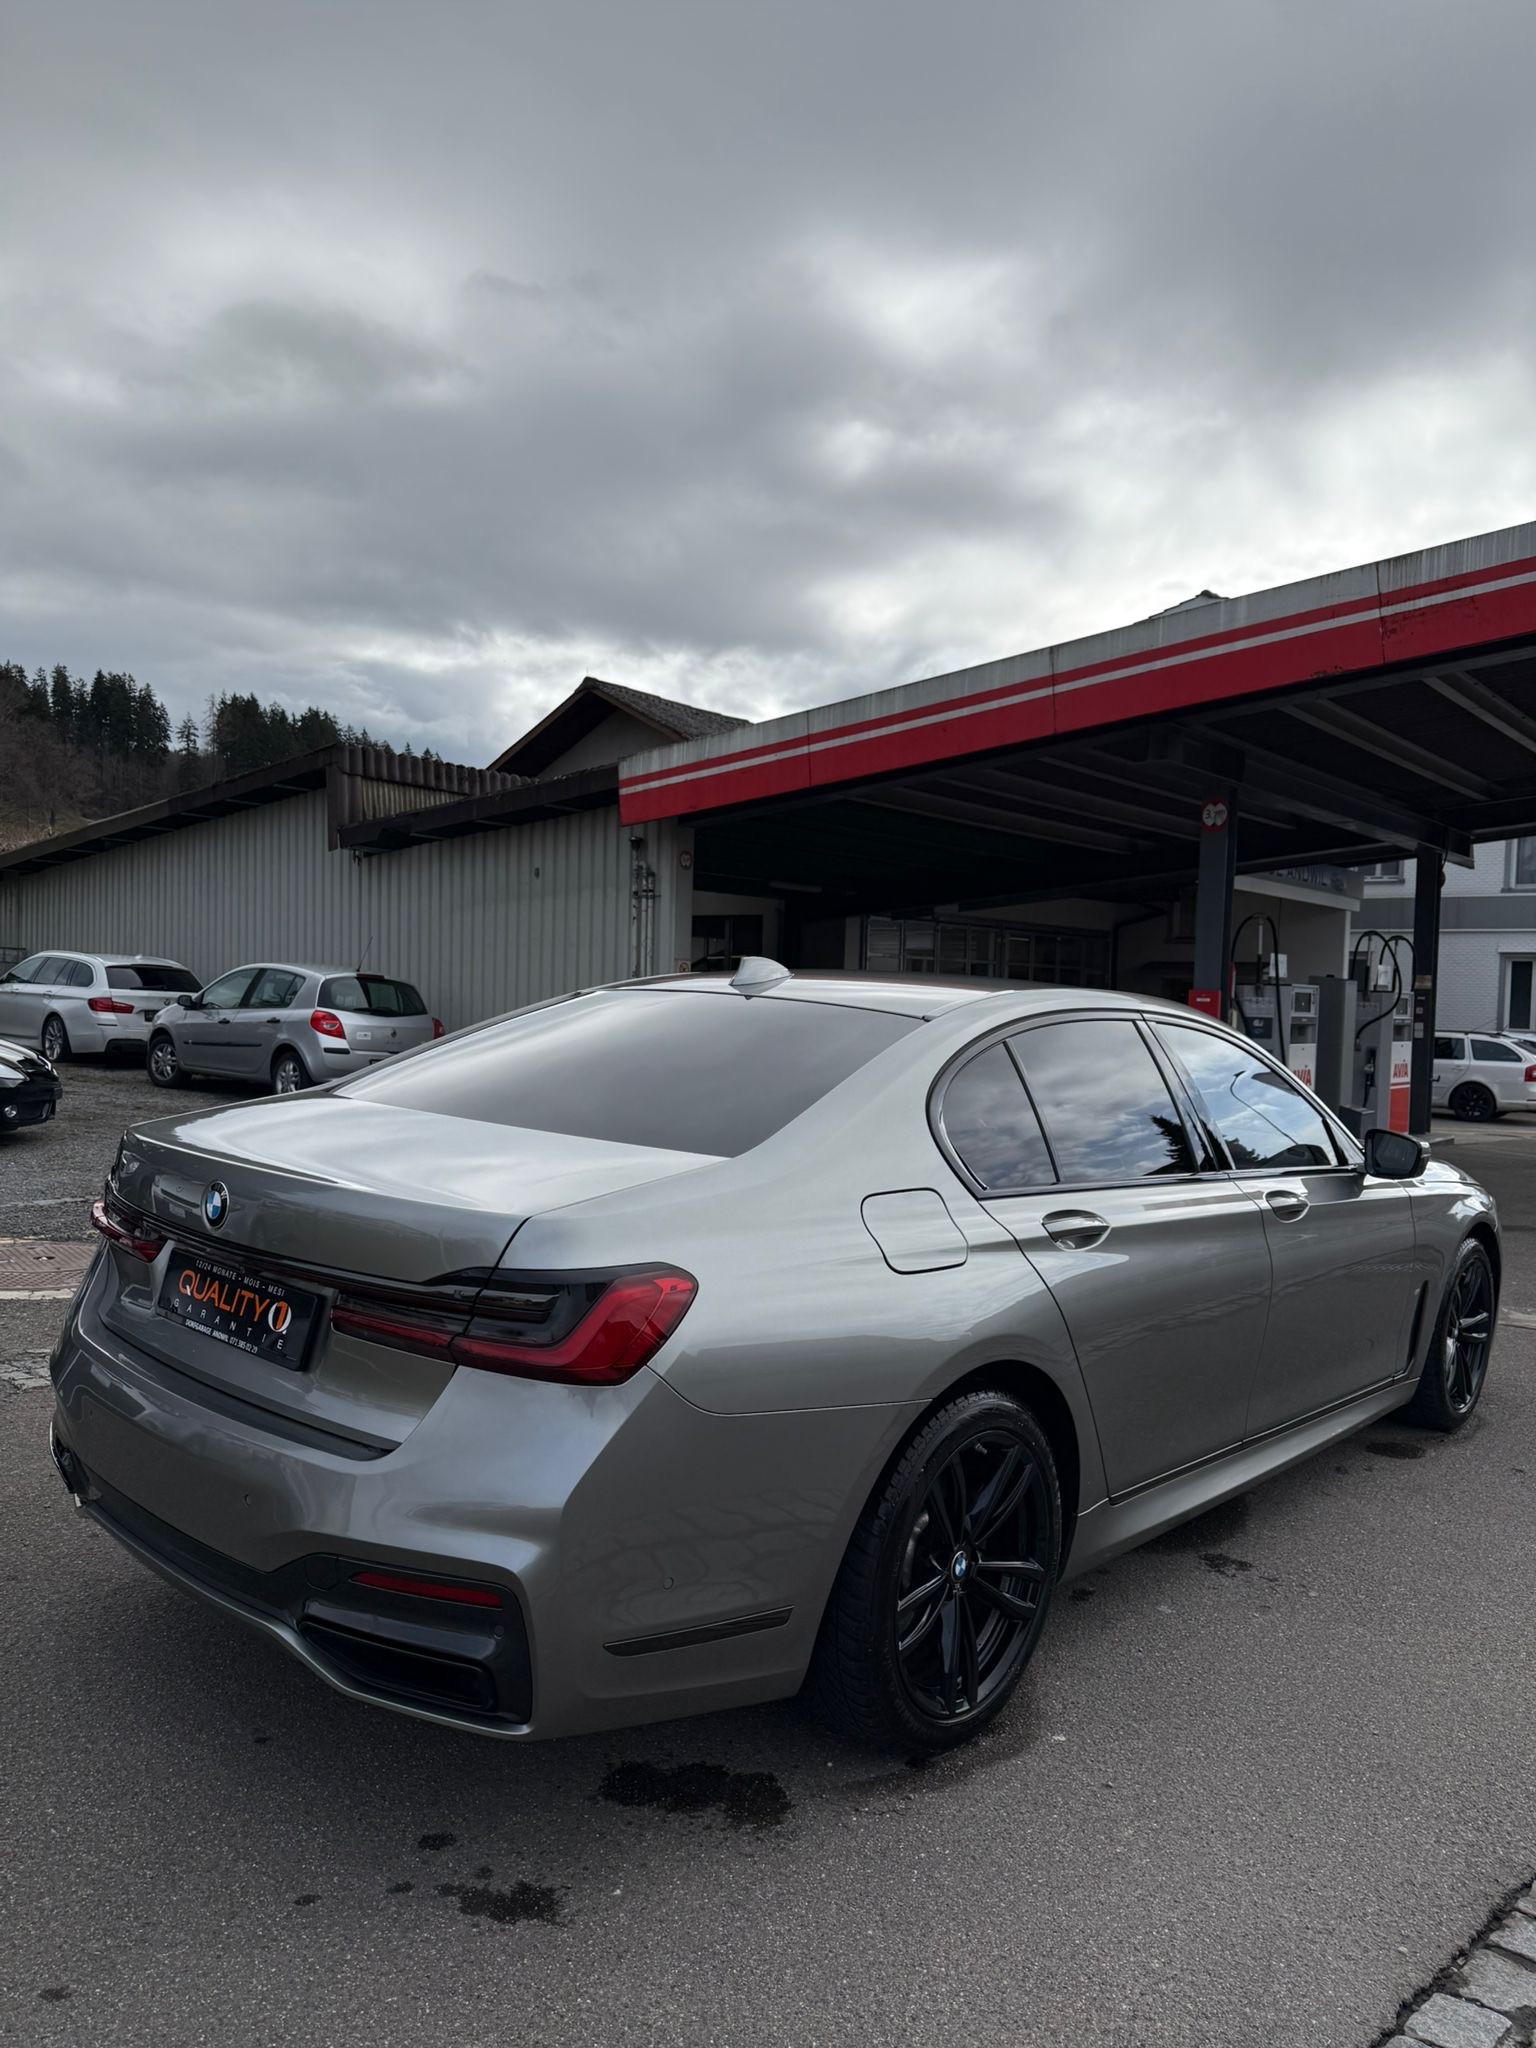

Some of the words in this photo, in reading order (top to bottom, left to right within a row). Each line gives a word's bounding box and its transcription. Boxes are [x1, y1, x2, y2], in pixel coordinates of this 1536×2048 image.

[1393, 1063, 1409, 1078] AVIA
[212, 1265, 236, 1280] MONATE
[243, 1276, 260, 1289] MOIS
[267, 1284, 285, 1296] MESI
[173, 1298, 285, 1350] GARANTIE
